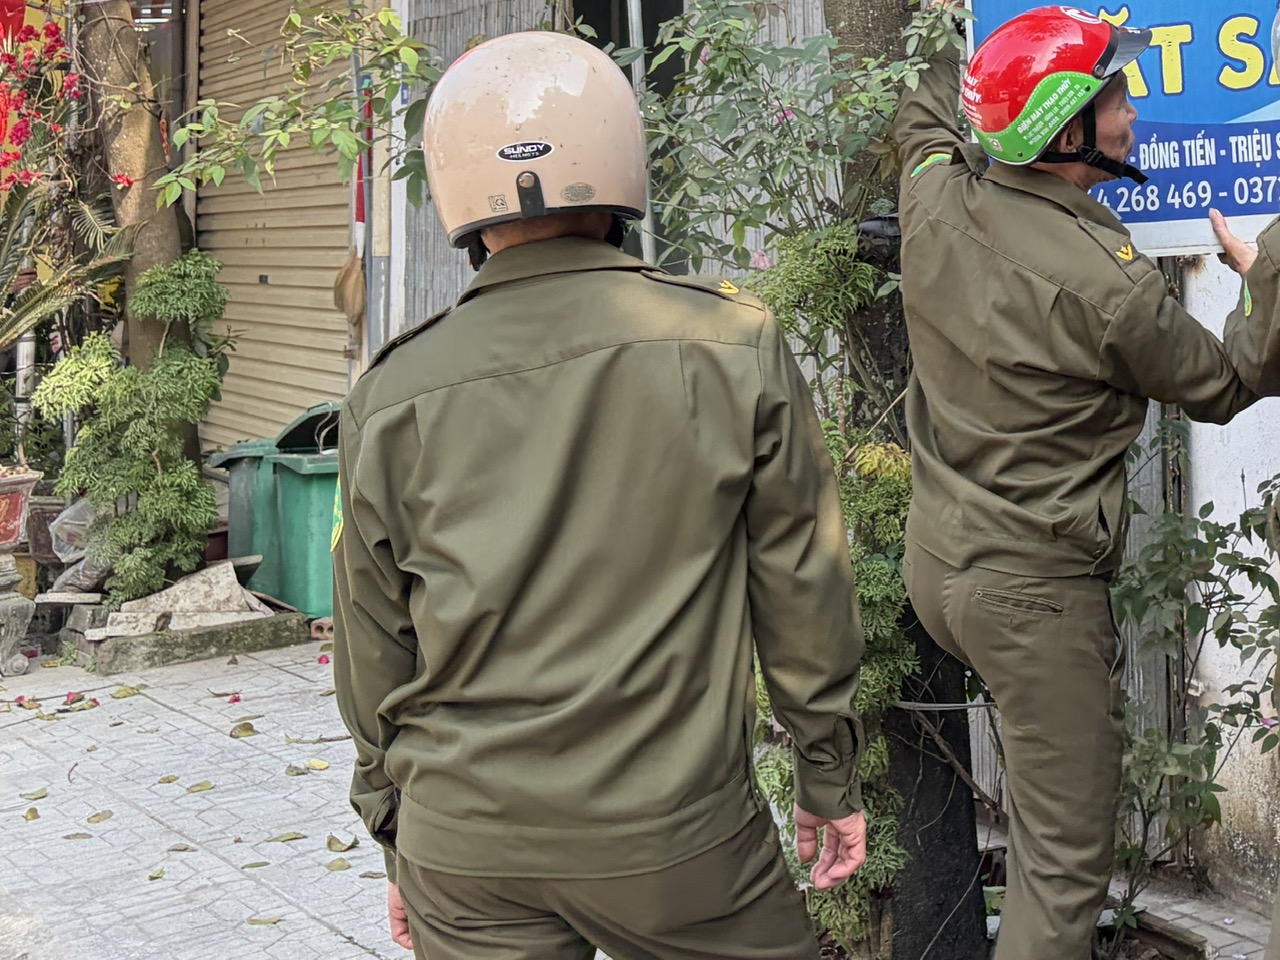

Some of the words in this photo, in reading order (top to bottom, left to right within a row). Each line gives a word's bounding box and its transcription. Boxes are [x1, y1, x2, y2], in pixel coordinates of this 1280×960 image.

[503, 143, 545, 155] SUNDY
[1139, 133, 1180, 170] ĐỒNG
[1183, 129, 1217, 167] TIẾN
[1229, 128, 1272, 168] TRIỆU
[1116, 184, 1160, 212] 268
[1166, 180, 1211, 209] 469
